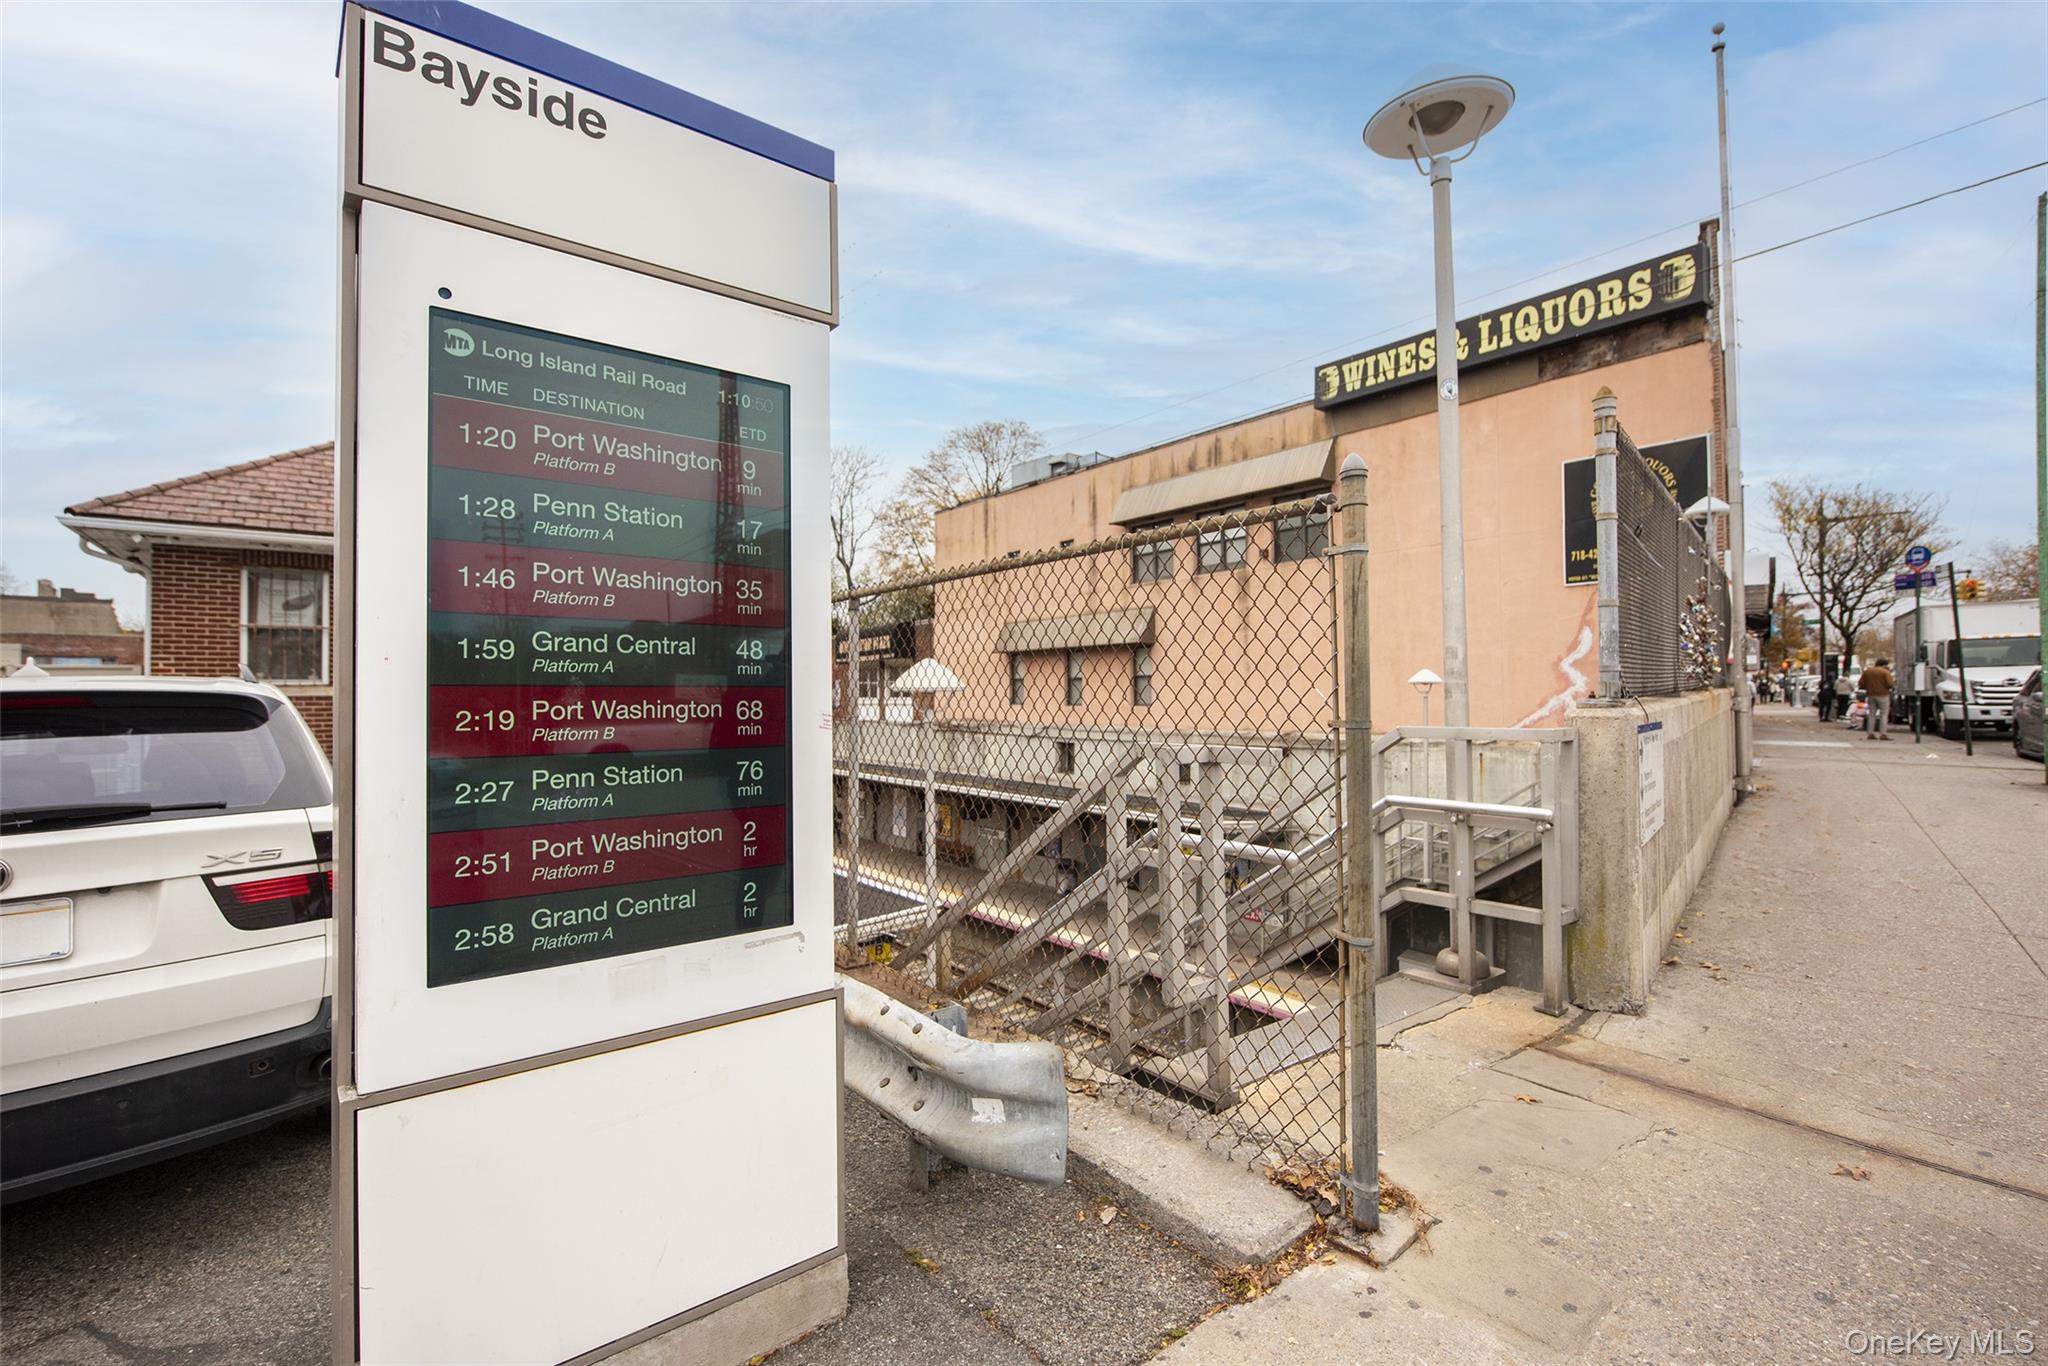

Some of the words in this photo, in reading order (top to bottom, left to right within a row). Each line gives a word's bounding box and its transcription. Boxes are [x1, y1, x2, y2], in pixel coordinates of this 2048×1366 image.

[373, 21, 608, 140] Bayside
[1342, 335, 1436, 393] WINES
[1478, 267, 1653, 355] LIQUORS
[443, 330, 472, 353] MTA
[482, 340, 533, 368] Long
[540, 352, 596, 378] Island
[603, 365, 636, 386] Rail
[642, 374, 687, 396] Road
[464, 375, 509, 396] TIME
[534, 389, 644, 420] DESTINATION
[739, 426, 767, 442] ETD
[459, 423, 516, 450] 1:20
[534, 425, 584, 452] Port
[593, 435, 722, 473] Washington
[743, 461, 756, 480] 9
[534, 452, 599, 474] Platform
[603, 463, 615, 476] B
[737, 483, 762, 497] min
[459, 494, 516, 520] 1:28
[534, 494, 595, 520] Penn
[604, 502, 683, 529] Station
[736, 520, 763, 540] 17
[533, 521, 599, 540] Platform
[602, 528, 614, 541] A
[737, 543, 762, 556] min
[458, 566, 515, 590] 1:46
[533, 562, 584, 585] Port
[592, 568, 722, 597] Washington
[736, 581, 763, 600] 35
[533, 591, 599, 607] Platform
[603, 594, 615, 607] B
[737, 603, 762, 616] min
[458, 636, 515, 660] 1:59
[532, 630, 608, 654] Grand
[616, 635, 696, 655] Central
[736, 640, 763, 659] 48
[533, 659, 599, 673] Platform
[602, 660, 614, 673] A
[737, 663, 762, 675] min
[455, 709, 515, 732] 2:19
[533, 701, 584, 721] Port
[592, 700, 722, 722] Washington
[736, 700, 763, 720] 68
[533, 727, 599, 742] Platform
[603, 727, 615, 740] B
[737, 723, 762, 735] min
[455, 781, 514, 805] 2:27
[532, 769, 595, 791] Penn
[603, 765, 683, 786] Station
[736, 761, 763, 781] 76
[738, 783, 762, 796] min
[532, 796, 598, 811] Platform
[602, 794, 614, 807] A
[201, 848, 283, 868] X5
[455, 852, 511, 879] 2:51
[532, 838, 584, 860] Port
[592, 826, 723, 854] Washington
[743, 821, 756, 841] 2
[744, 842, 757, 857] hr
[532, 862, 598, 882] Platform
[602, 860, 615, 874] B
[455, 923, 514, 951] 2:58
[531, 901, 608, 930] Grand
[616, 889, 696, 918] Central
[743, 882, 756, 902] 2
[744, 904, 758, 918] hr
[532, 929, 598, 952] Platform
[602, 926, 614, 941] A
